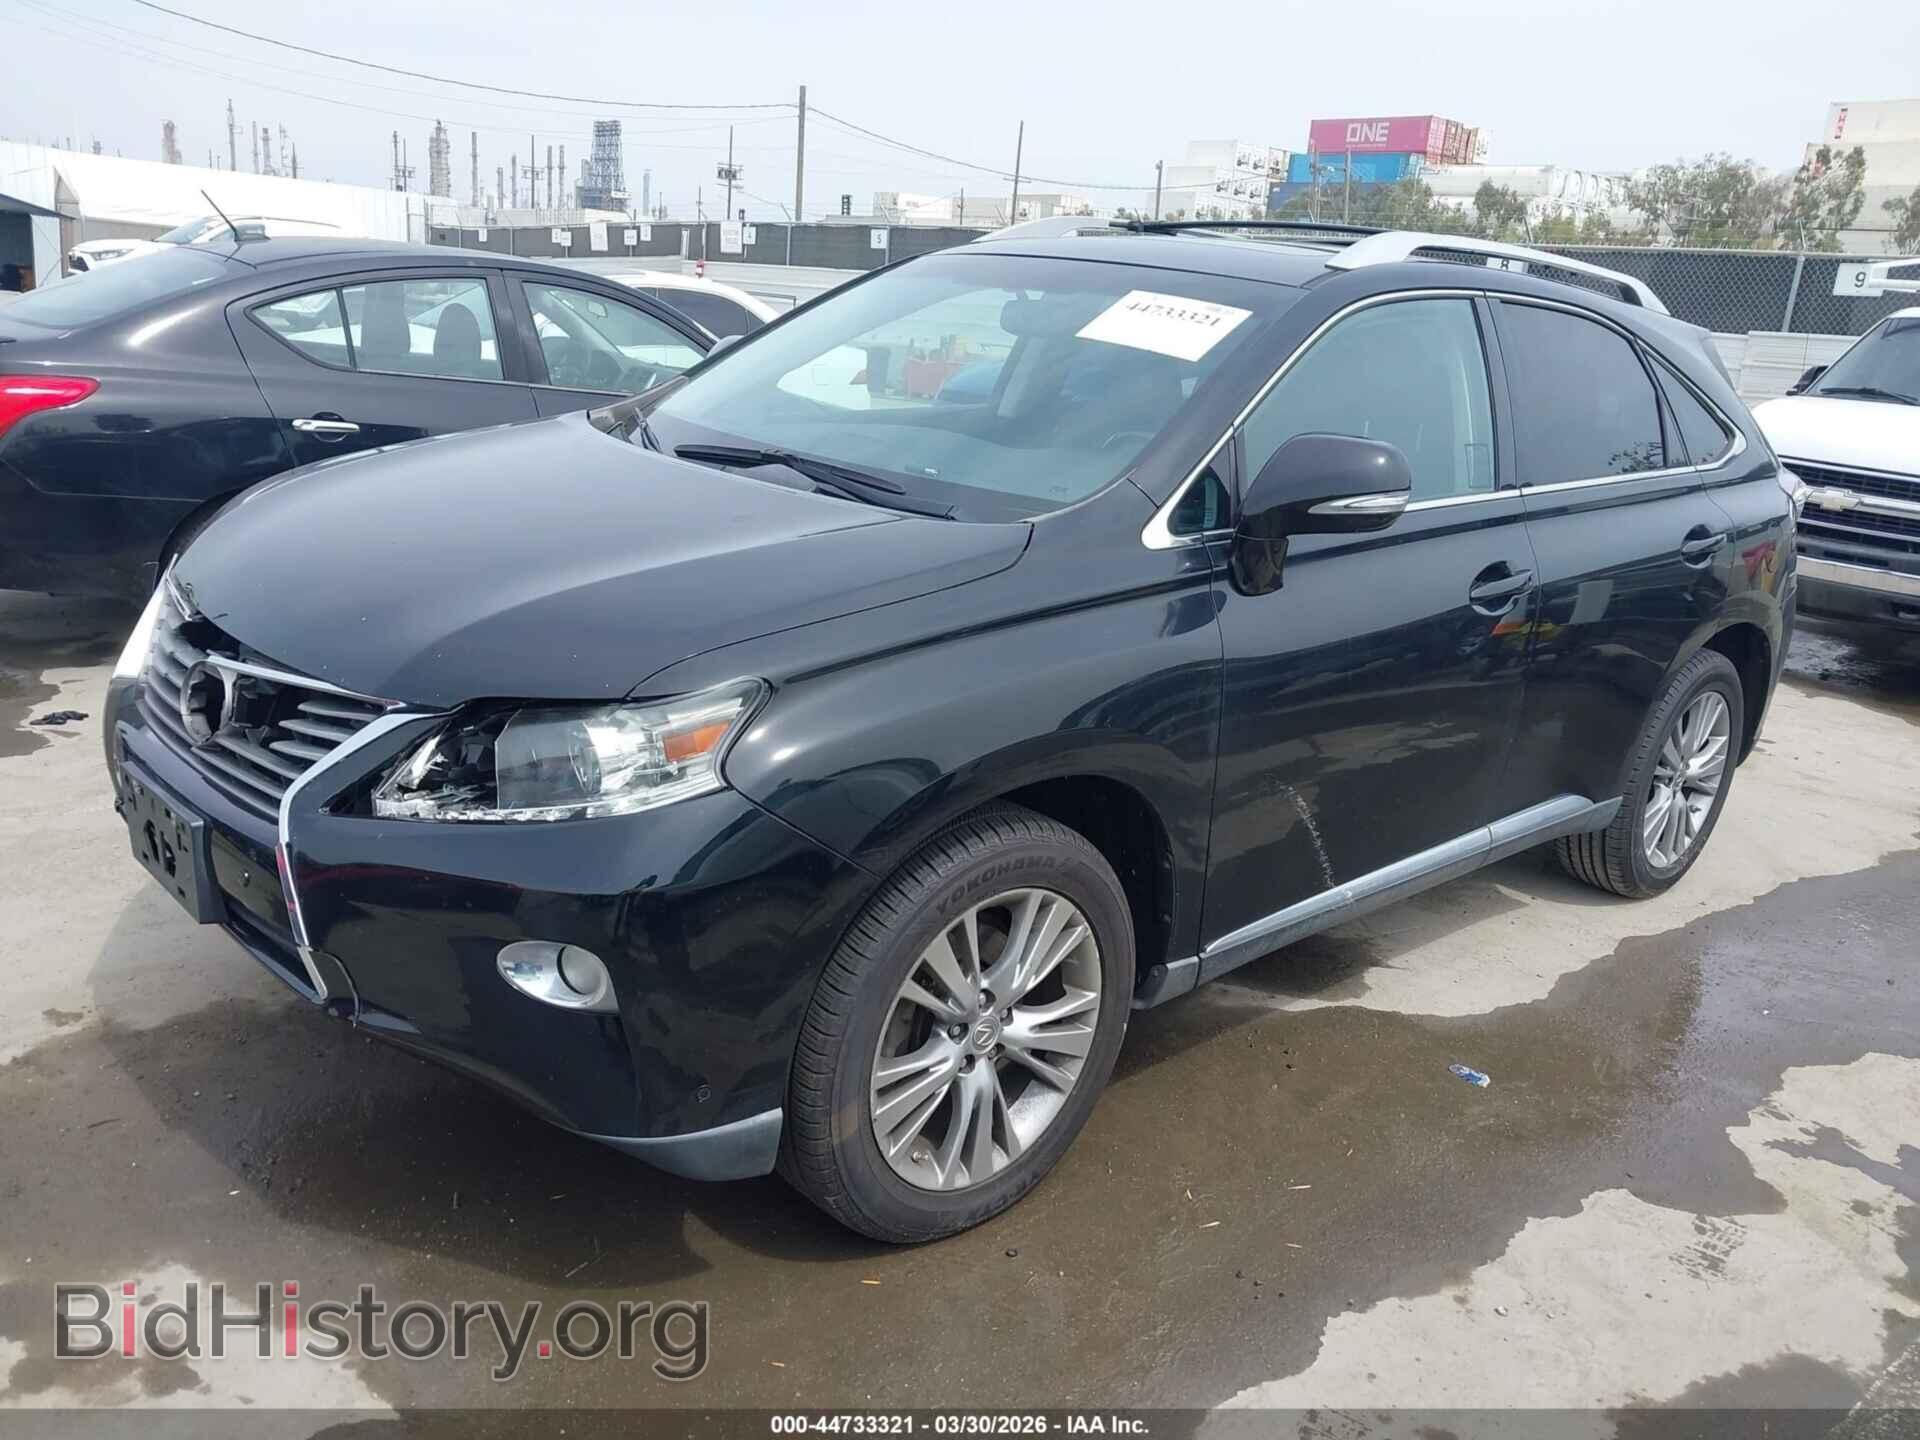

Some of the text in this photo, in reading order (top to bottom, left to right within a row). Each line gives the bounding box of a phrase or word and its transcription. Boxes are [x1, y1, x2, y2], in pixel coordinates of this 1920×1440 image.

[1347, 123, 1390, 142] ONE
[1854, 271, 1867, 288] 9
[1126, 302, 1221, 326] 44733321
[936, 855, 1057, 914] YOKOHAMA
